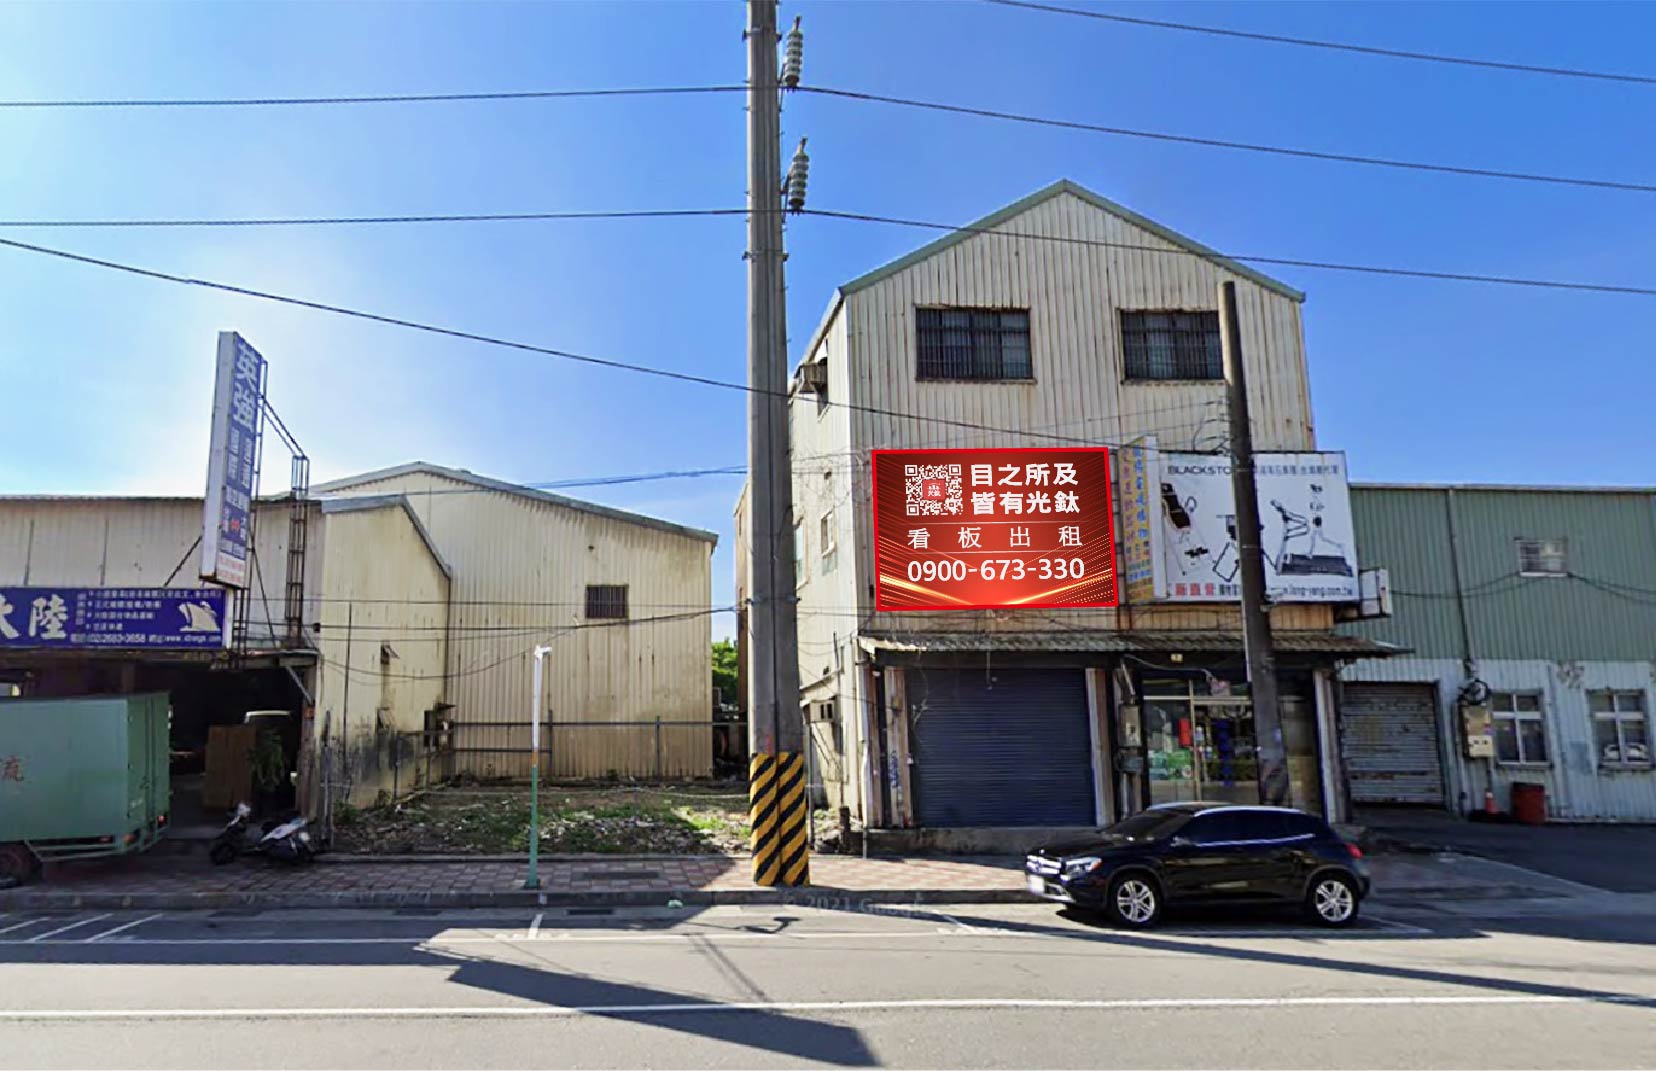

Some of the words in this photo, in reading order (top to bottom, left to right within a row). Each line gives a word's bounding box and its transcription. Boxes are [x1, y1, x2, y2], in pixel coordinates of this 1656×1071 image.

[970, 463, 1079, 486] 目之所及
[1168, 466, 1232, 475] BLACKSTO
[970, 490, 1081, 515] 皆有光鈦
[907, 525, 1083, 550] 看板出租
[907, 558, 1085, 582] 0900-673-330
